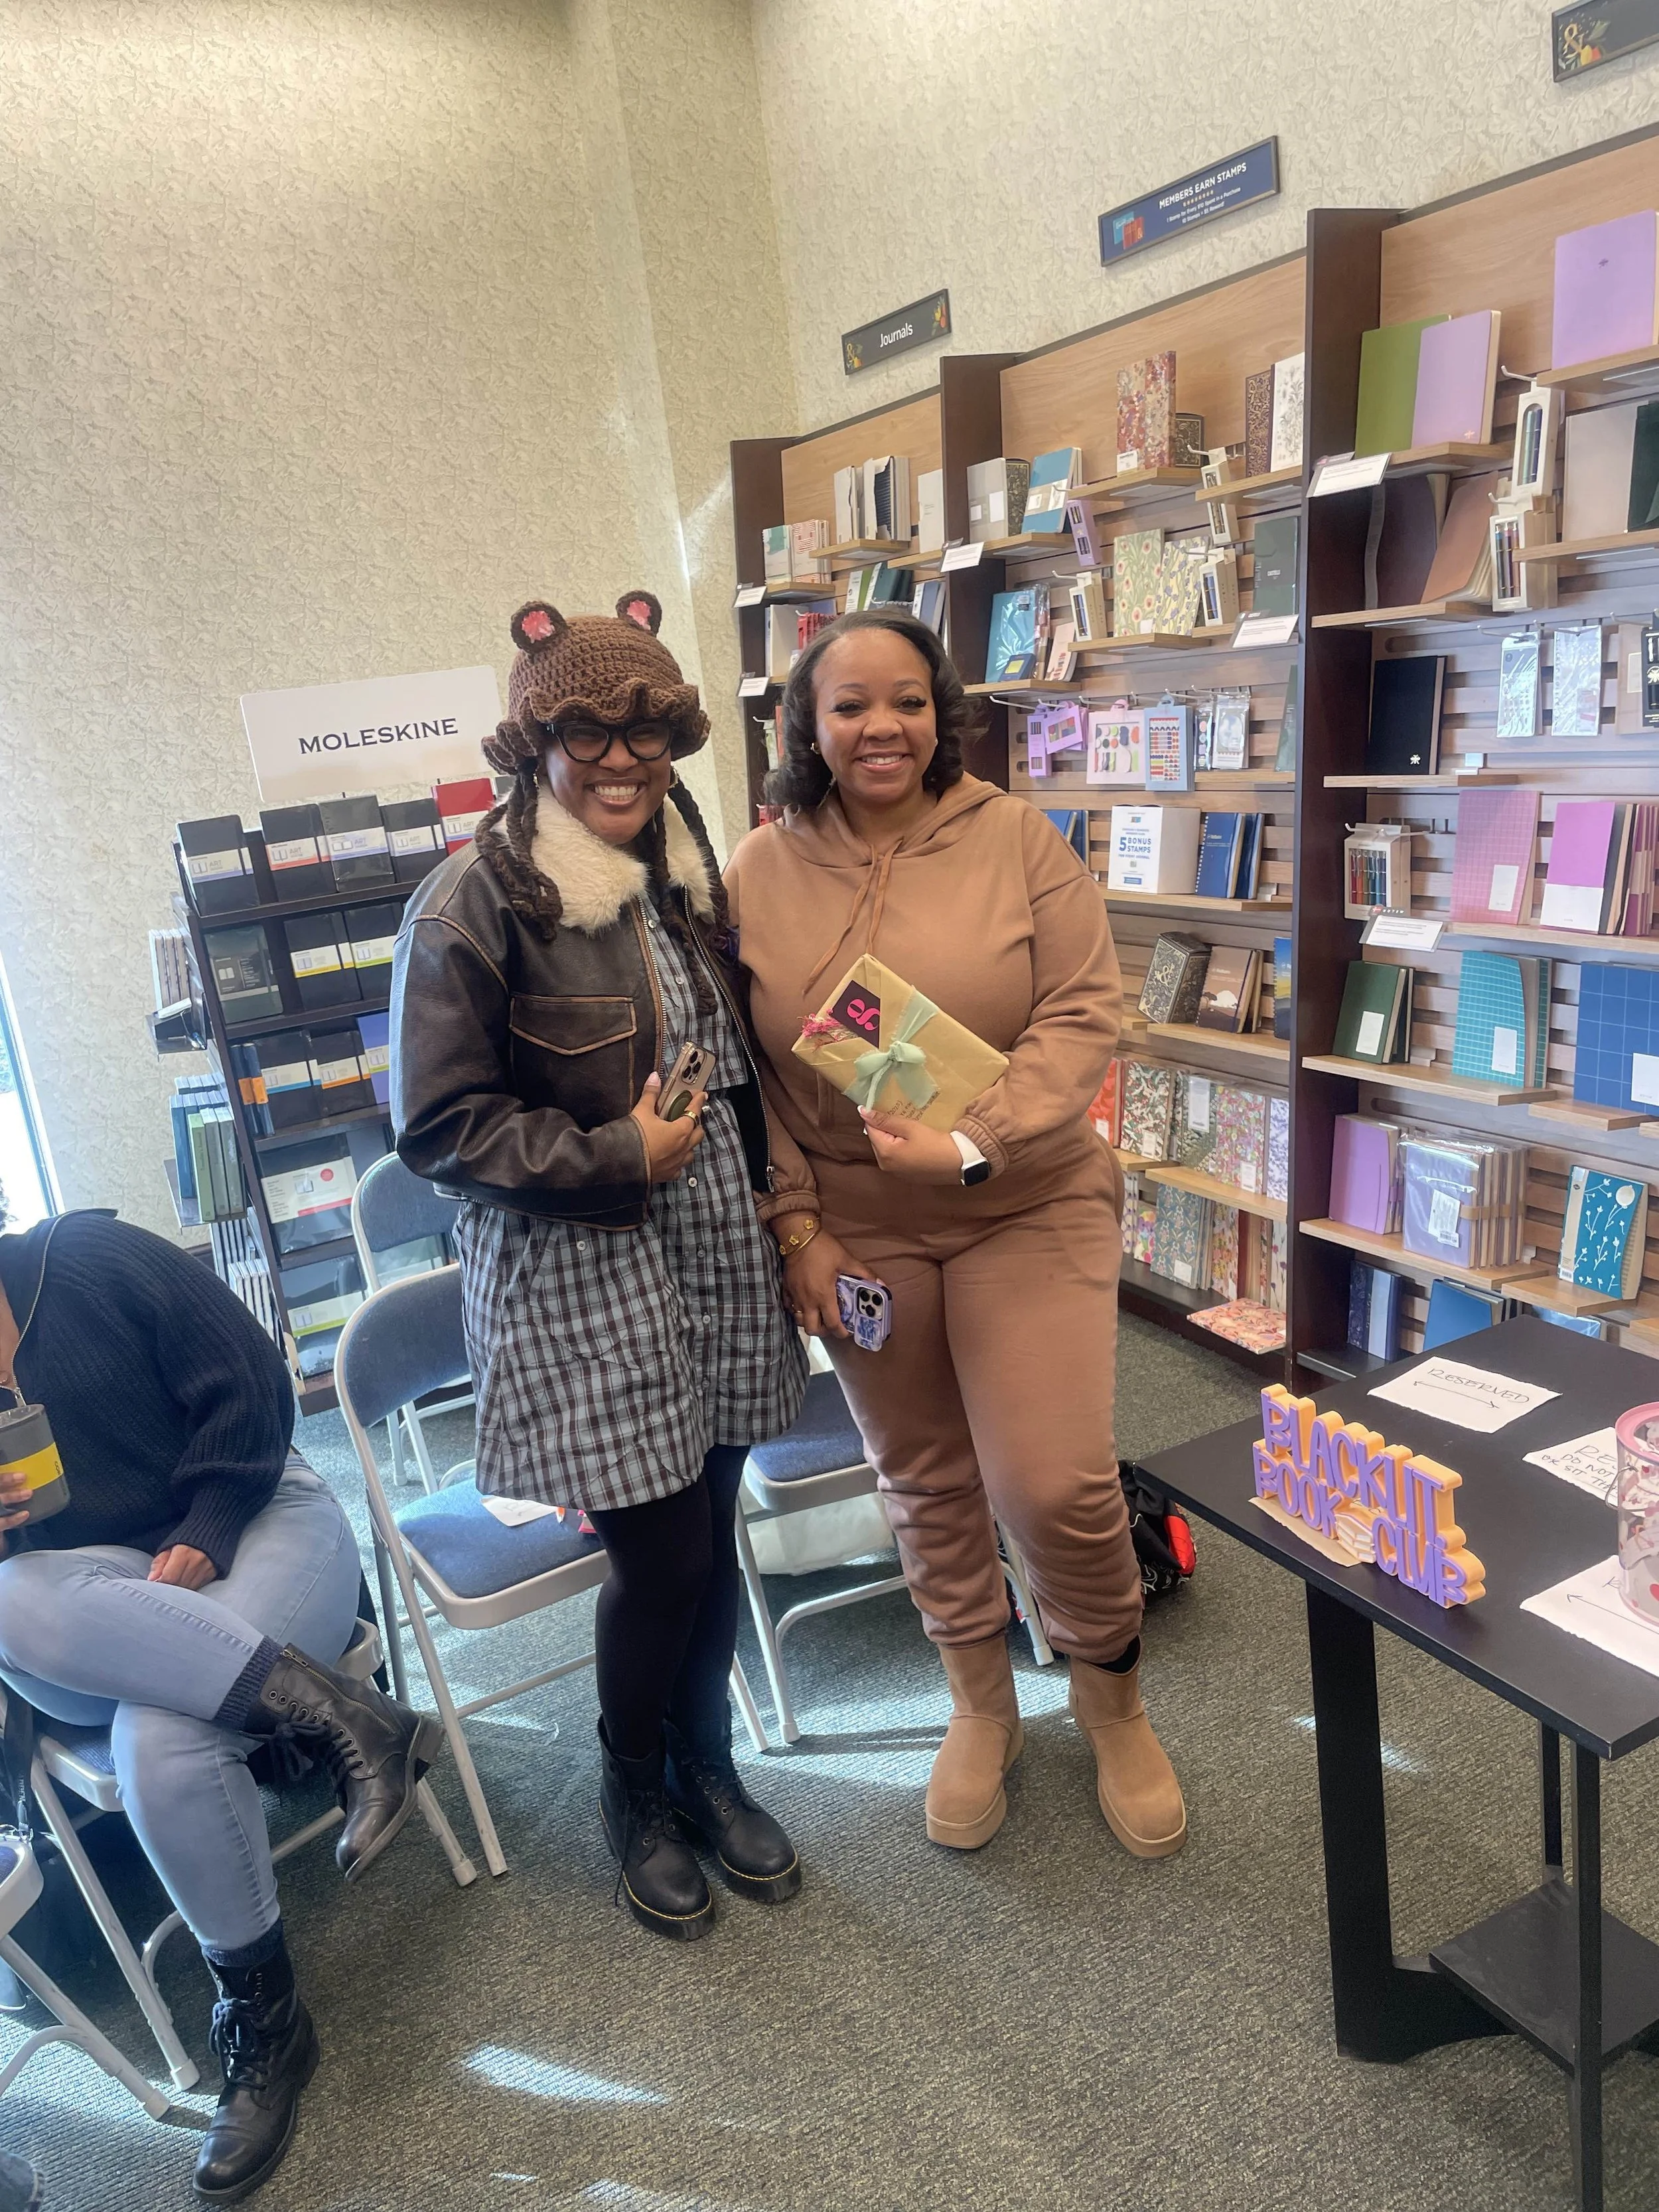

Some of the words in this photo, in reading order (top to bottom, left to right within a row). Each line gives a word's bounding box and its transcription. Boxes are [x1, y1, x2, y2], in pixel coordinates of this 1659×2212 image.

[1159, 186, 1194, 210] MEMBERS
[1194, 177, 1216, 193] EARN
[1216, 162, 1248, 184] STAMPS
[880, 323, 914, 348] Journals
[299, 718, 458, 754] MOLESKINE
[1119, 837, 1127, 851] 5
[1428, 1368, 1530, 1403] RESERVED
[1261, 1388, 1451, 1546] BLACKLIT
[1561, 1453, 1581, 1464] DO
[1585, 1464, 1615, 1477] NOT
[1564, 1465, 1587, 1475] SIT
[1253, 1442, 1344, 1539] BOOK
[1373, 1516, 1477, 1609] CLUB
